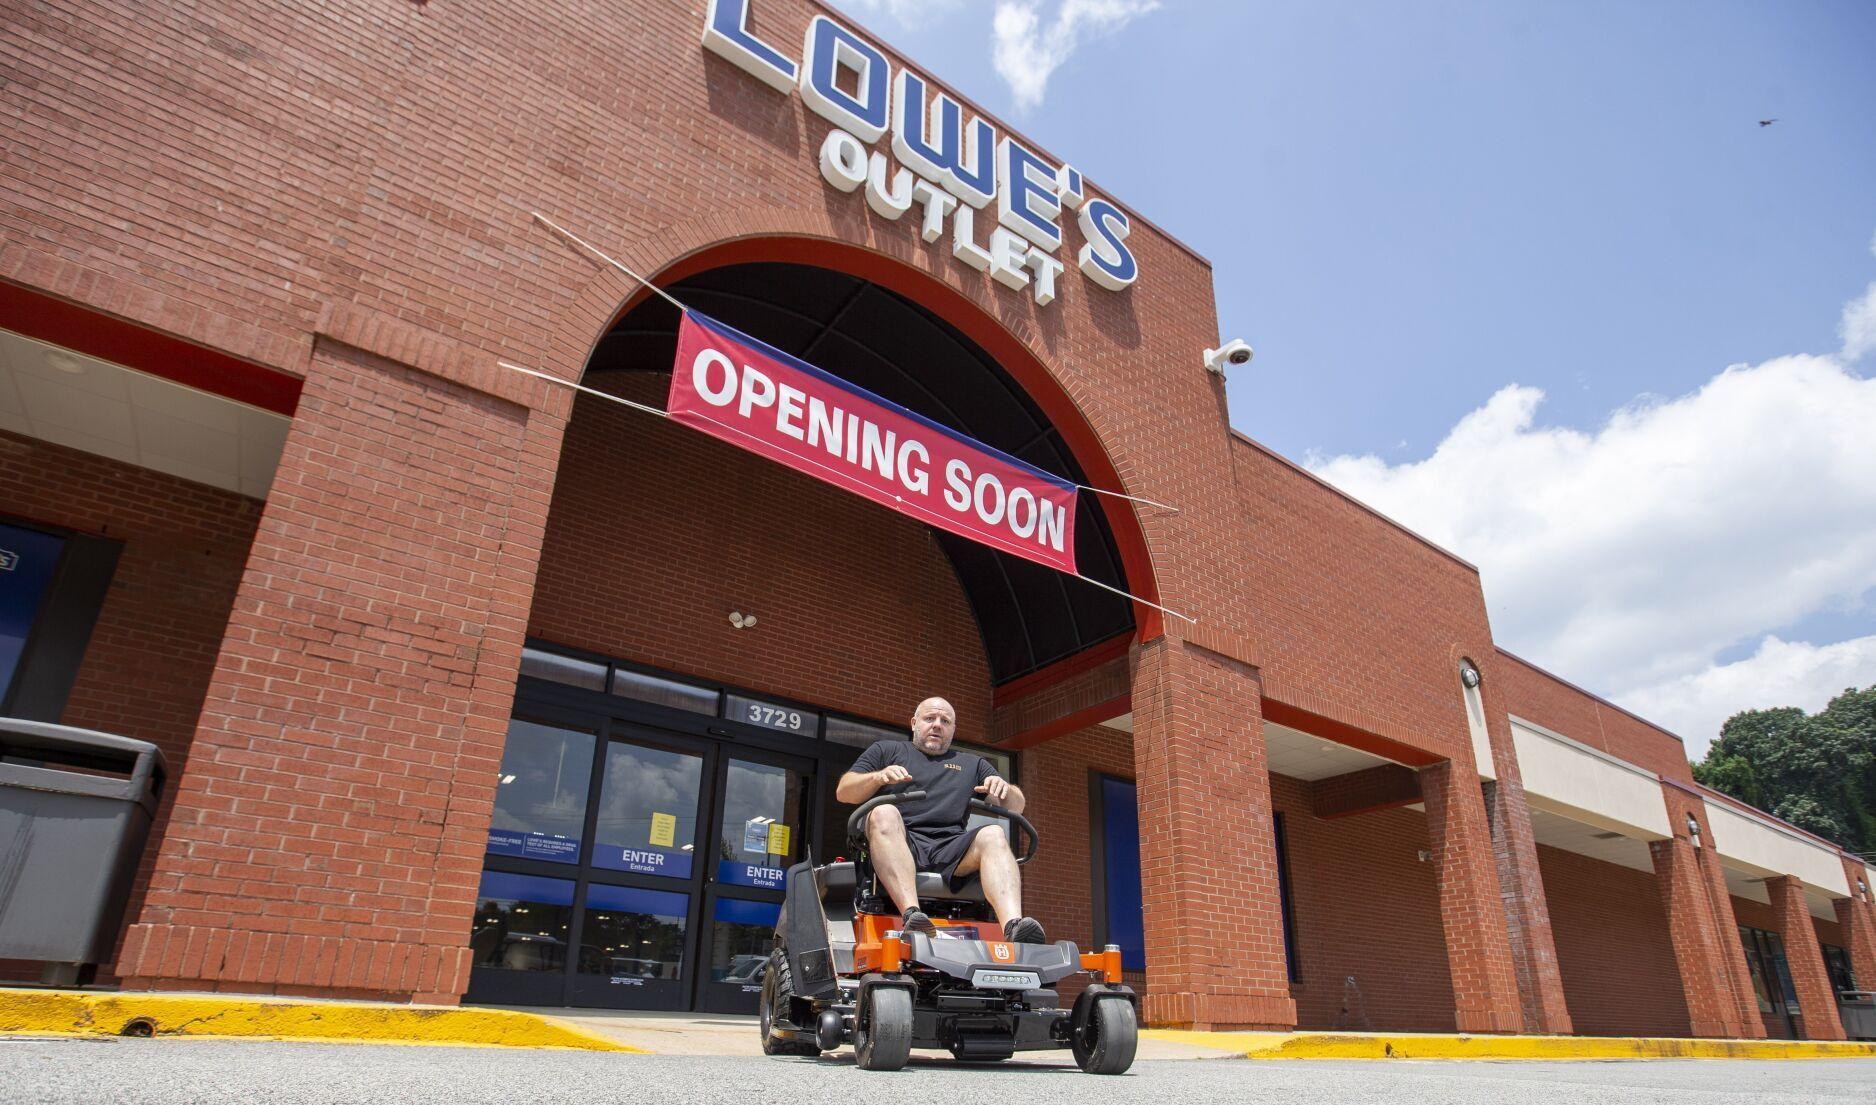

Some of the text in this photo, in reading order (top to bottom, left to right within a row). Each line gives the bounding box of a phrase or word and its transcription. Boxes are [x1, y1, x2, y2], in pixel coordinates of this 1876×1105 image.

[702, 0, 1138, 291] LOWE'S
[820, 129, 1064, 306] OUTLET
[692, 348, 1065, 552] OPENING SOON
[749, 704, 801, 730] 3729
[622, 850, 664, 866] ENTER
[630, 863, 655, 872] Entrada
[746, 866, 783, 880] ENTER
[753, 879, 776, 887] Entrada
